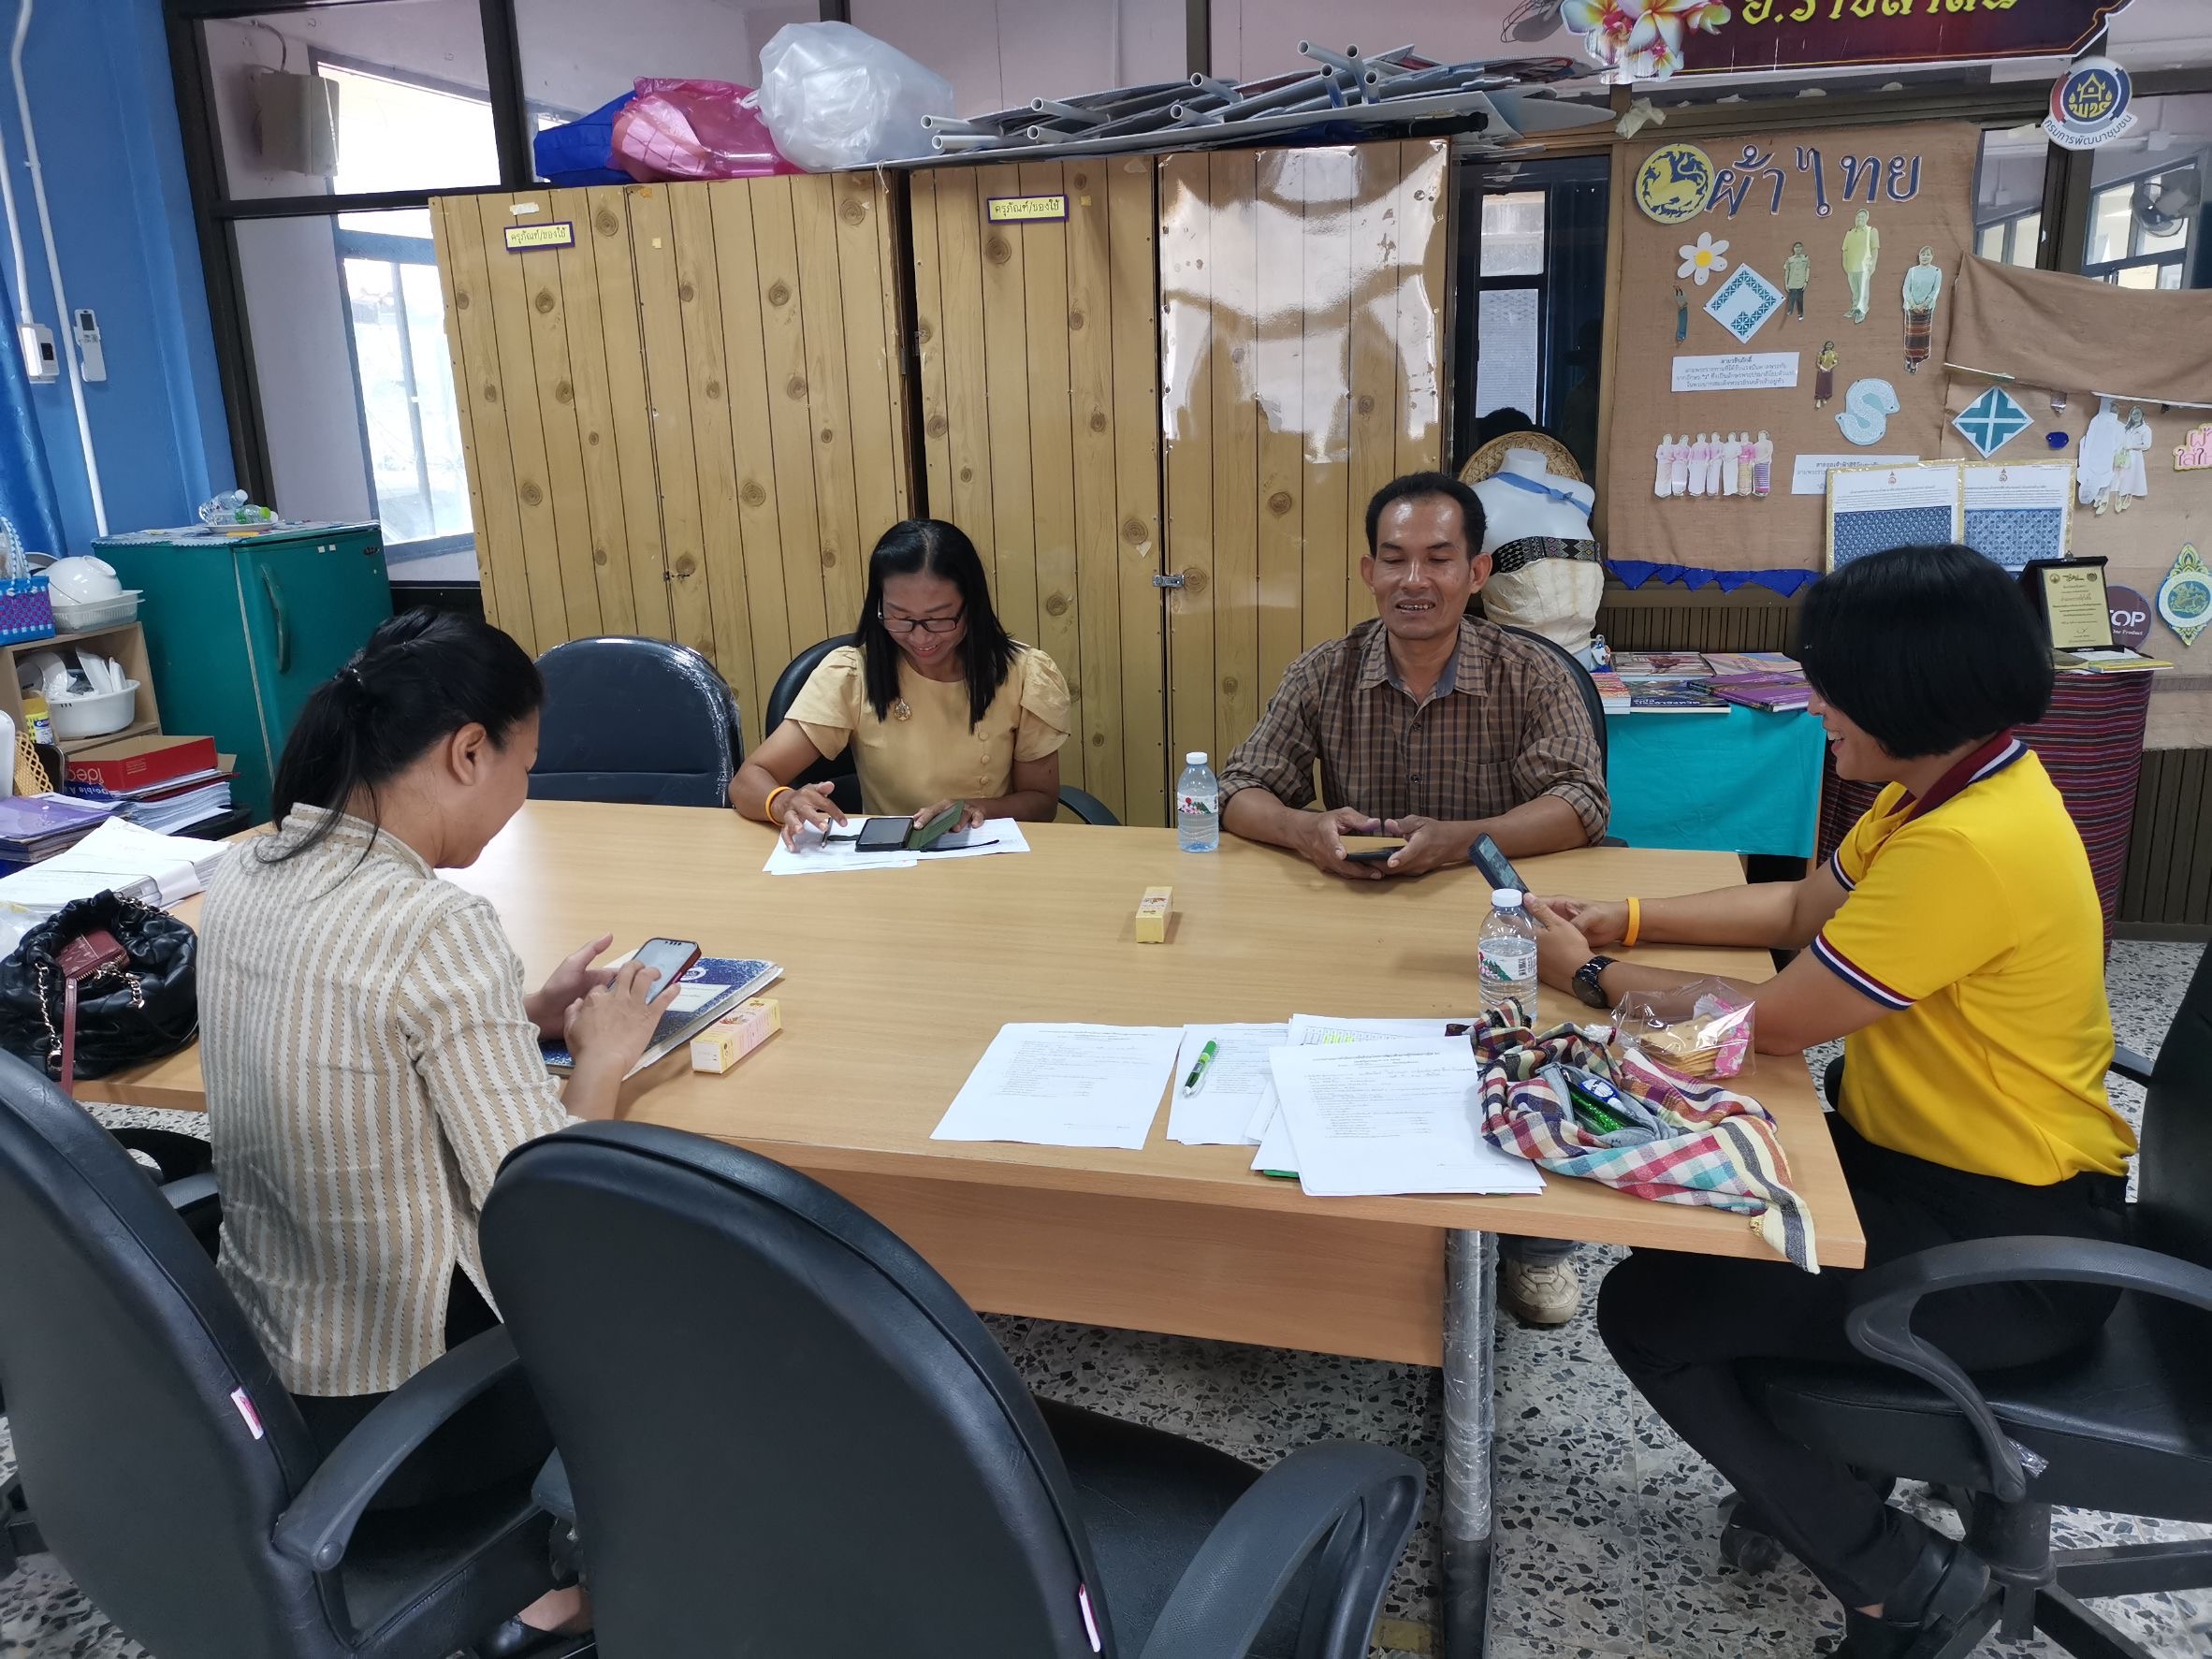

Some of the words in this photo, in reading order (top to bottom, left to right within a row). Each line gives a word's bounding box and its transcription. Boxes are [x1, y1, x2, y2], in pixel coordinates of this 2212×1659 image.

[2044, 114, 2132, 146] กรมการพัฒนาชุมชน
[2110, 610, 2146, 627] OP
